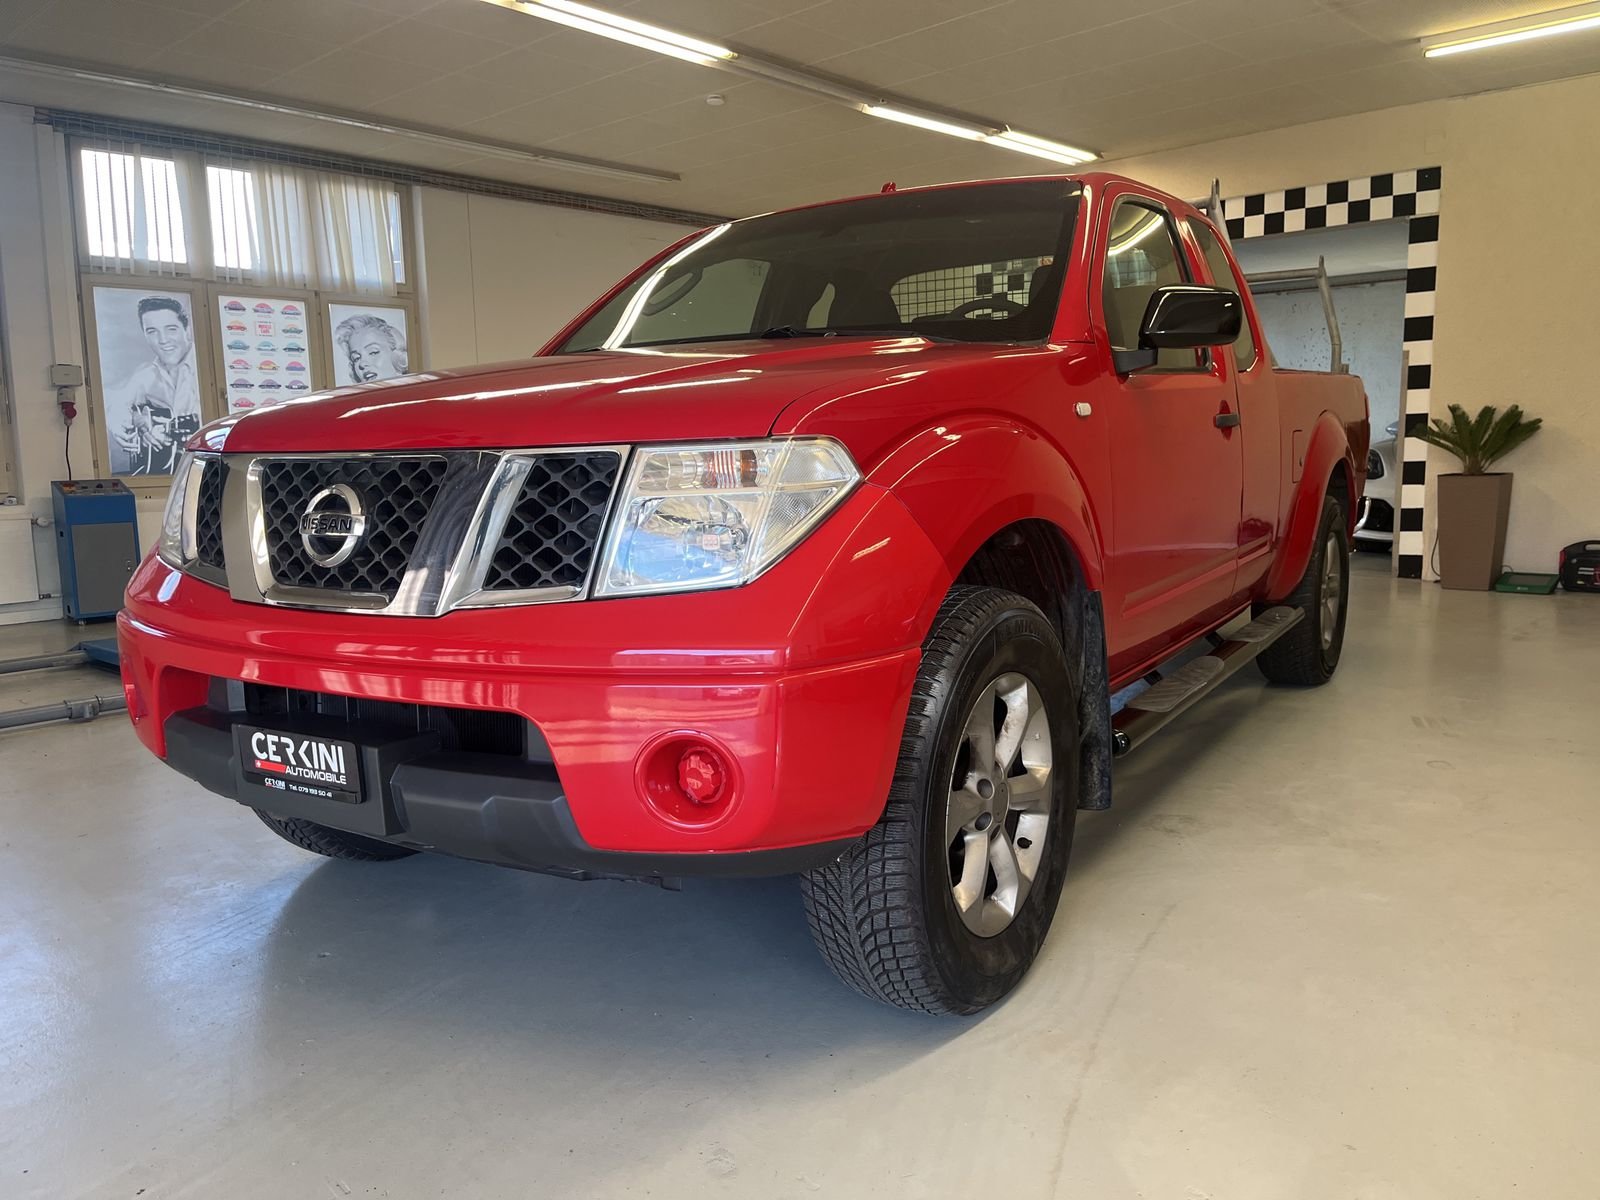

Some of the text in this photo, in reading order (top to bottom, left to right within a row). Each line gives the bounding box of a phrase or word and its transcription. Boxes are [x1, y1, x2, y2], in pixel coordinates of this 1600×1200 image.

[302, 517, 352, 531] NISSAN
[251, 732, 345, 774] CERKINI
[285, 765, 347, 784] AUTOMOBILE
